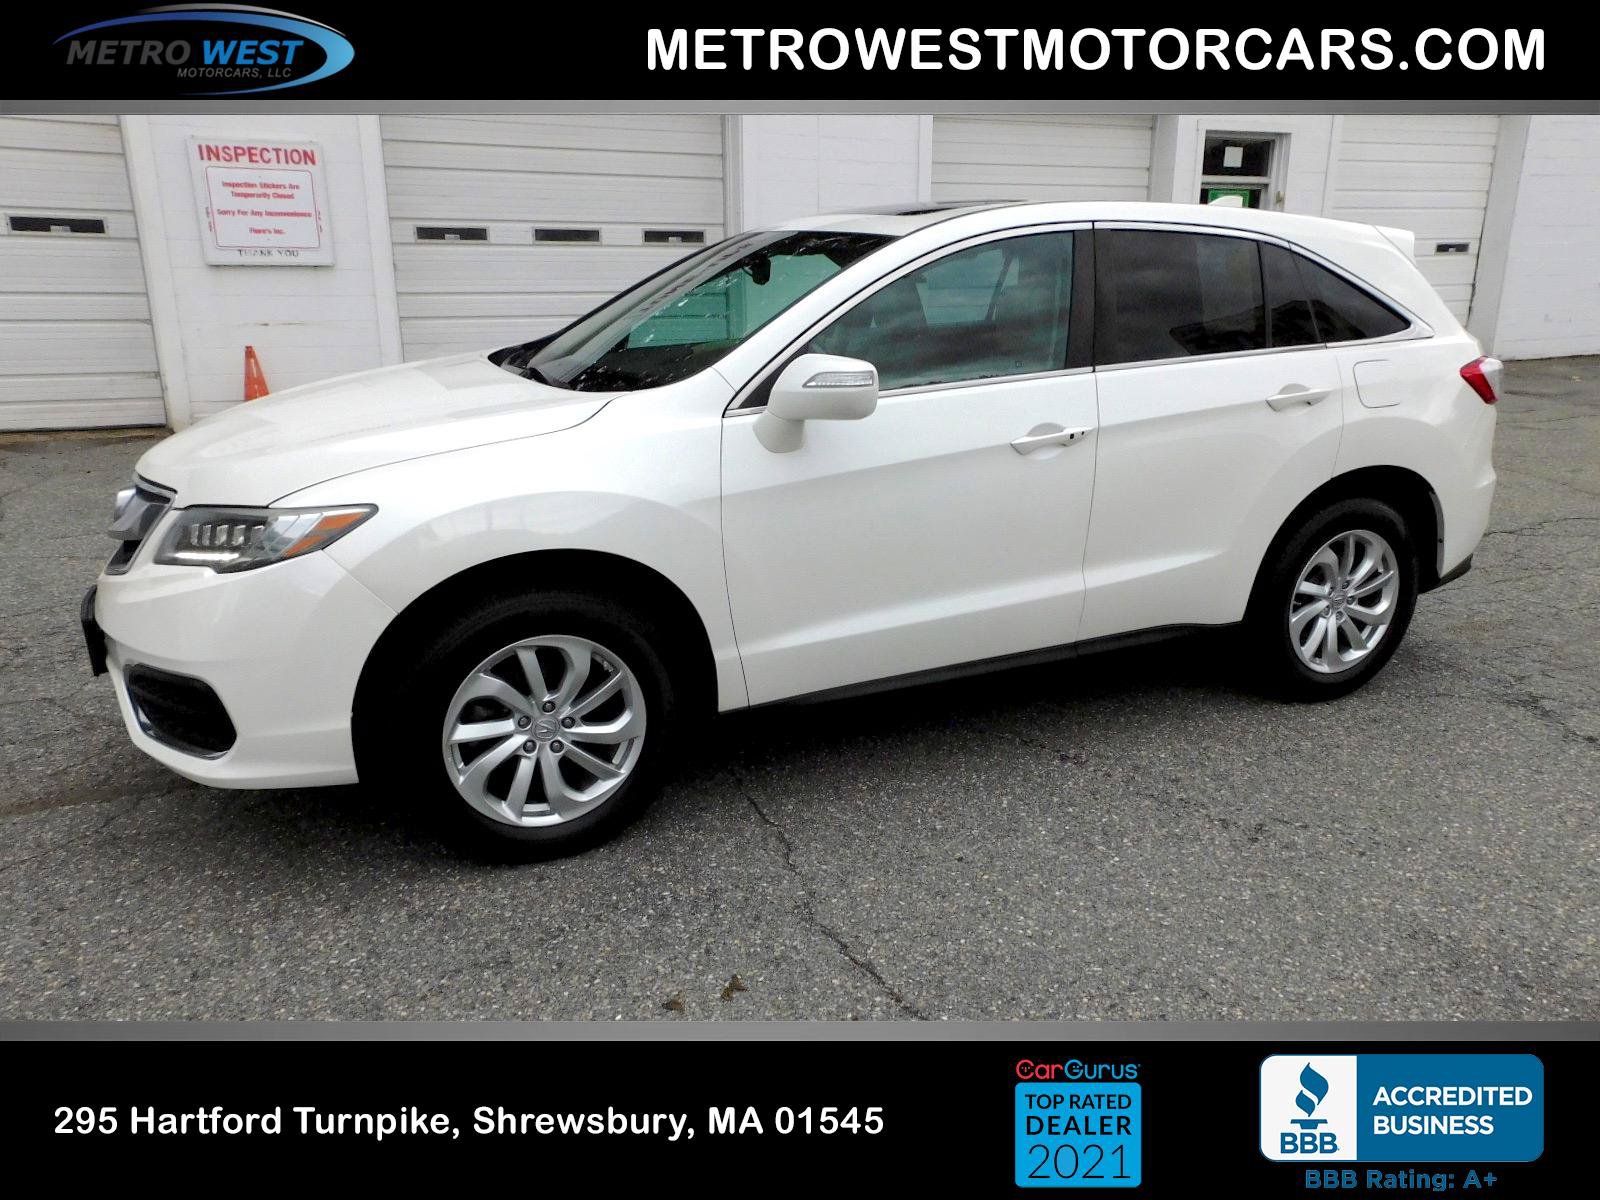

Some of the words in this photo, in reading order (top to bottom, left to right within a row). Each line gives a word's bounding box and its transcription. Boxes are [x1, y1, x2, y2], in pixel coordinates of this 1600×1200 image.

[198, 144, 317, 166] INSPECTION
[222, 181, 257, 189] Inspection
[260, 181, 286, 190] Stickers
[217, 209, 235, 217] Sorry
[237, 249, 273, 257] THANK
[277, 249, 299, 257] YOU
